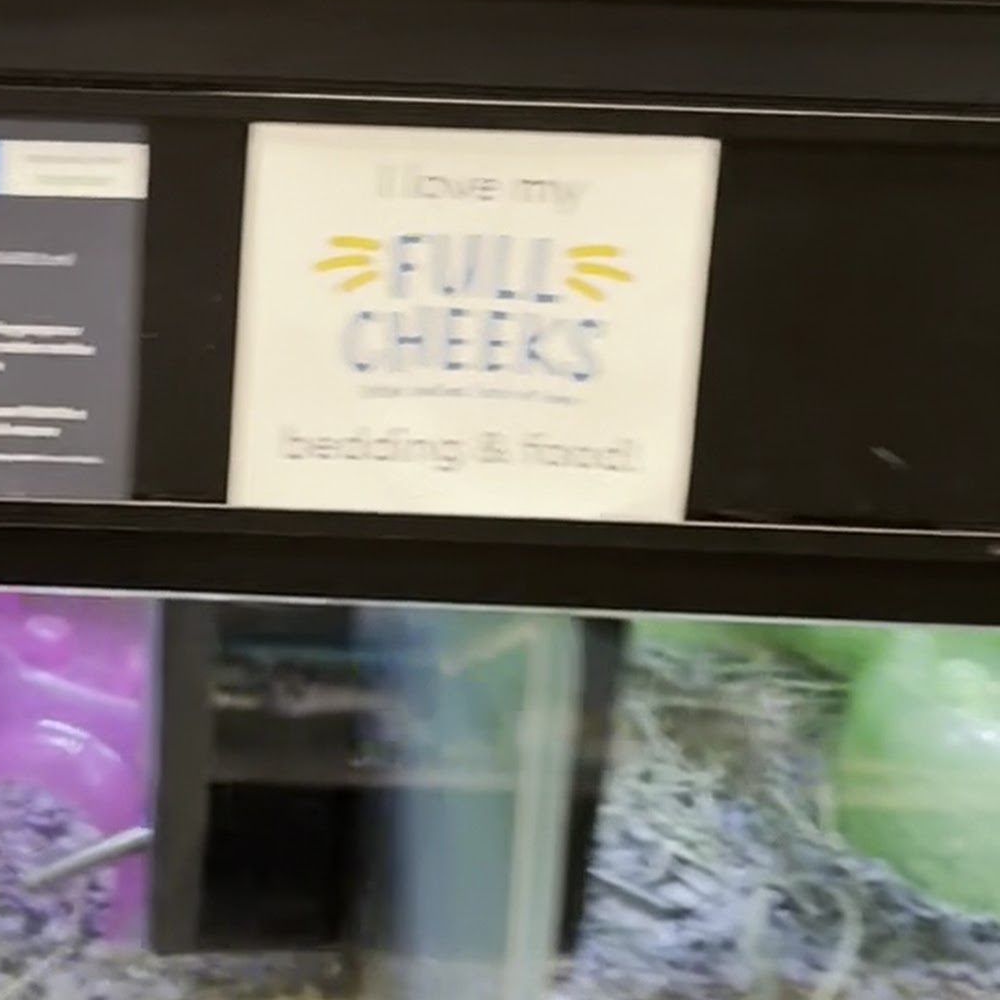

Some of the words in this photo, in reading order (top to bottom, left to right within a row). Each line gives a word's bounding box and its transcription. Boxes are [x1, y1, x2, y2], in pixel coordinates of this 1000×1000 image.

[401, 163, 501, 201] love
[513, 178, 592, 213] my
[387, 233, 560, 302] FULL
[339, 306, 605, 382] CHEEKS
[278, 426, 464, 474] bedding
